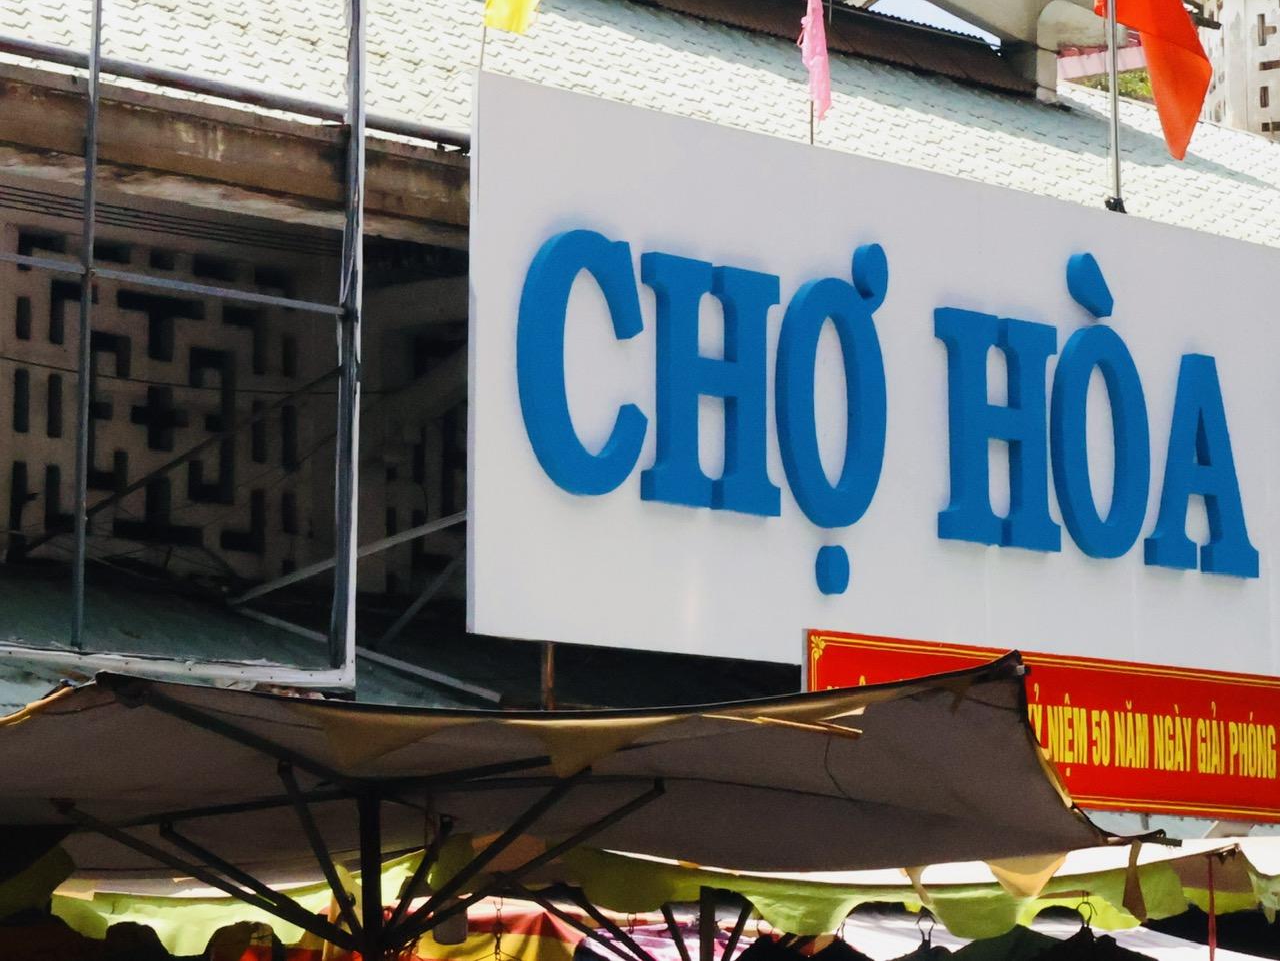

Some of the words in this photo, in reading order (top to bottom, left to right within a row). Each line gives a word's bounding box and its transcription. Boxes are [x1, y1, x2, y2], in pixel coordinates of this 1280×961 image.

[516, 229, 888, 595] CHỢ
[932, 251, 1260, 579] HÒA
[1047, 692, 1088, 777] NIỆM
[1091, 710, 1110, 767] 50
[1114, 699, 1149, 769] NĂM
[1153, 704, 1192, 772] NGÀY
[1197, 701, 1225, 775] GIẢI
[1228, 711, 1276, 779] PHÓNG
